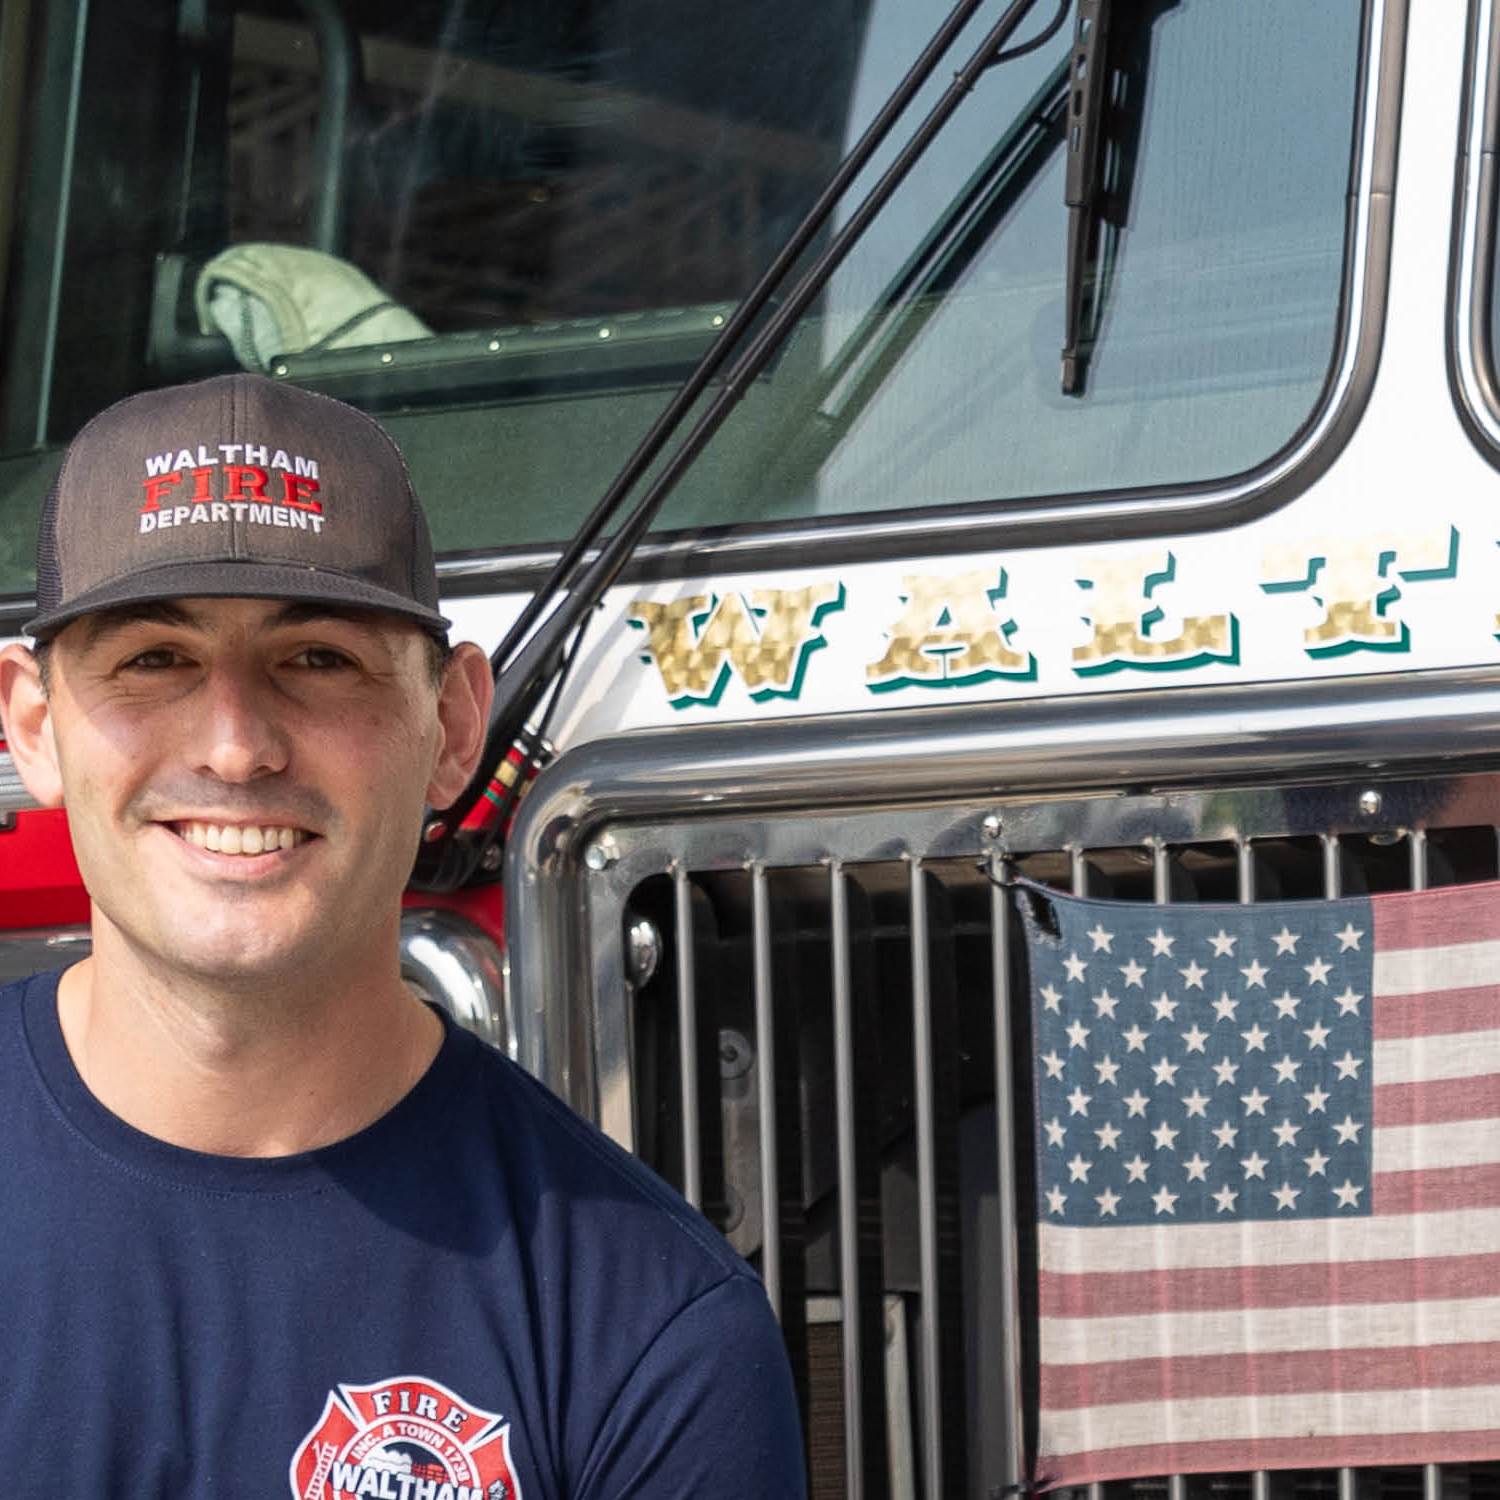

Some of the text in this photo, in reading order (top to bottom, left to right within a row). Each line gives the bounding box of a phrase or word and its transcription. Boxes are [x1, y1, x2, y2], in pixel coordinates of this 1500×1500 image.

[145, 443, 320, 480] WALTHAM
[139, 465, 323, 514] FIRE
[139, 501, 325, 535] DEPARTMENT
[371, 1389, 469, 1434] FIRE
[350, 1432, 381, 1461] INC.
[383, 1424, 396, 1439] A
[399, 1422, 446, 1447] TOWN
